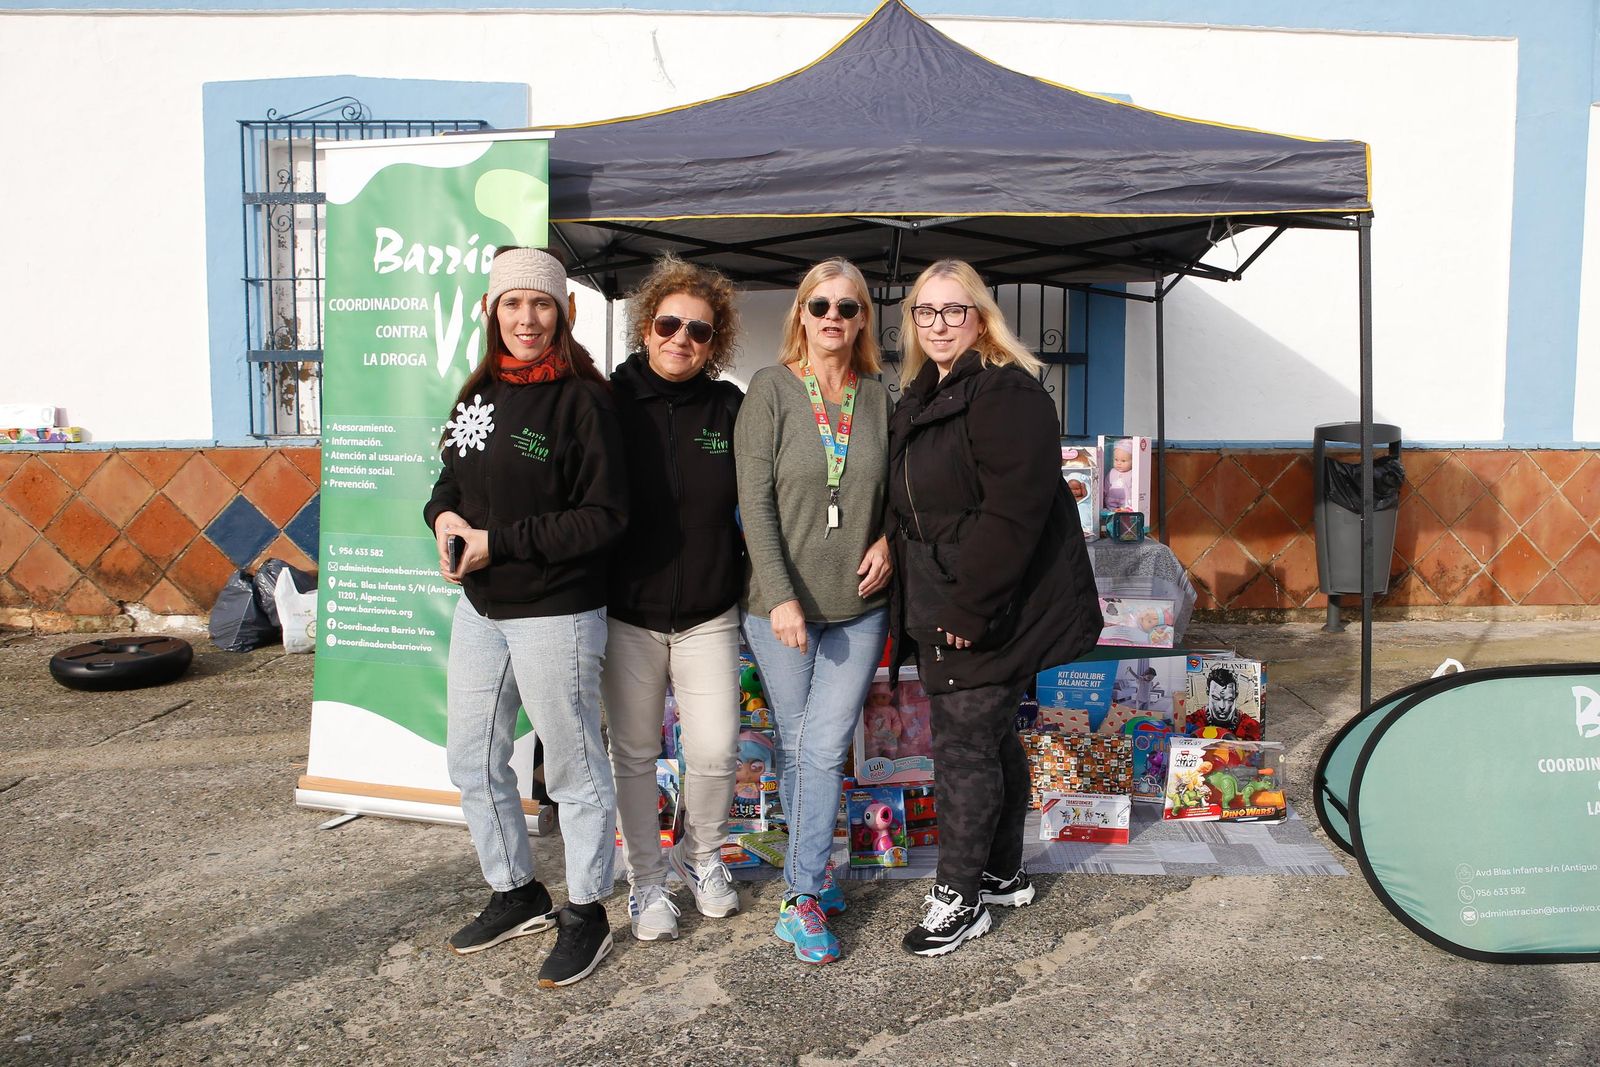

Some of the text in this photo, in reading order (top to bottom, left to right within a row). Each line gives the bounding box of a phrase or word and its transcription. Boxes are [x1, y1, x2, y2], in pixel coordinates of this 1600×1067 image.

[329, 297, 429, 312] COORDINADORA
[375, 325, 428, 339] CONTRA
[363, 353, 427, 367] LA DROGA
[332, 423, 396, 433] Asesoramiento.
[331, 437, 383, 447] Información.
[331, 451, 425, 463] Atención al usuario/a.
[330, 465, 396, 477] Atención social.
[329, 479, 378, 490] Prevención.
[338, 546, 384, 557] 956 633 582
[337, 579, 359, 589] Avda.
[361, 580, 377, 590] Blas
[378, 581, 406, 592] Infante
[408, 583, 426, 594] S/N
[337, 591, 397, 603] 11201, Algeciras.
[337, 604, 413, 619] www.barriovivo.org
[337, 622, 435, 637] Coordinadora Barrio Vivo
[1058, 669, 1106, 680] KIT ÉQUILIBRE
[1057, 679, 1089, 688] BALANCE
[868, 760, 885, 772] Luli
[1538, 757, 1600, 773] COORDIN
[1475, 863, 1598, 877] Avd Blas Infante s/n (Antiguo
[1475, 886, 1526, 898] 956 633 582
